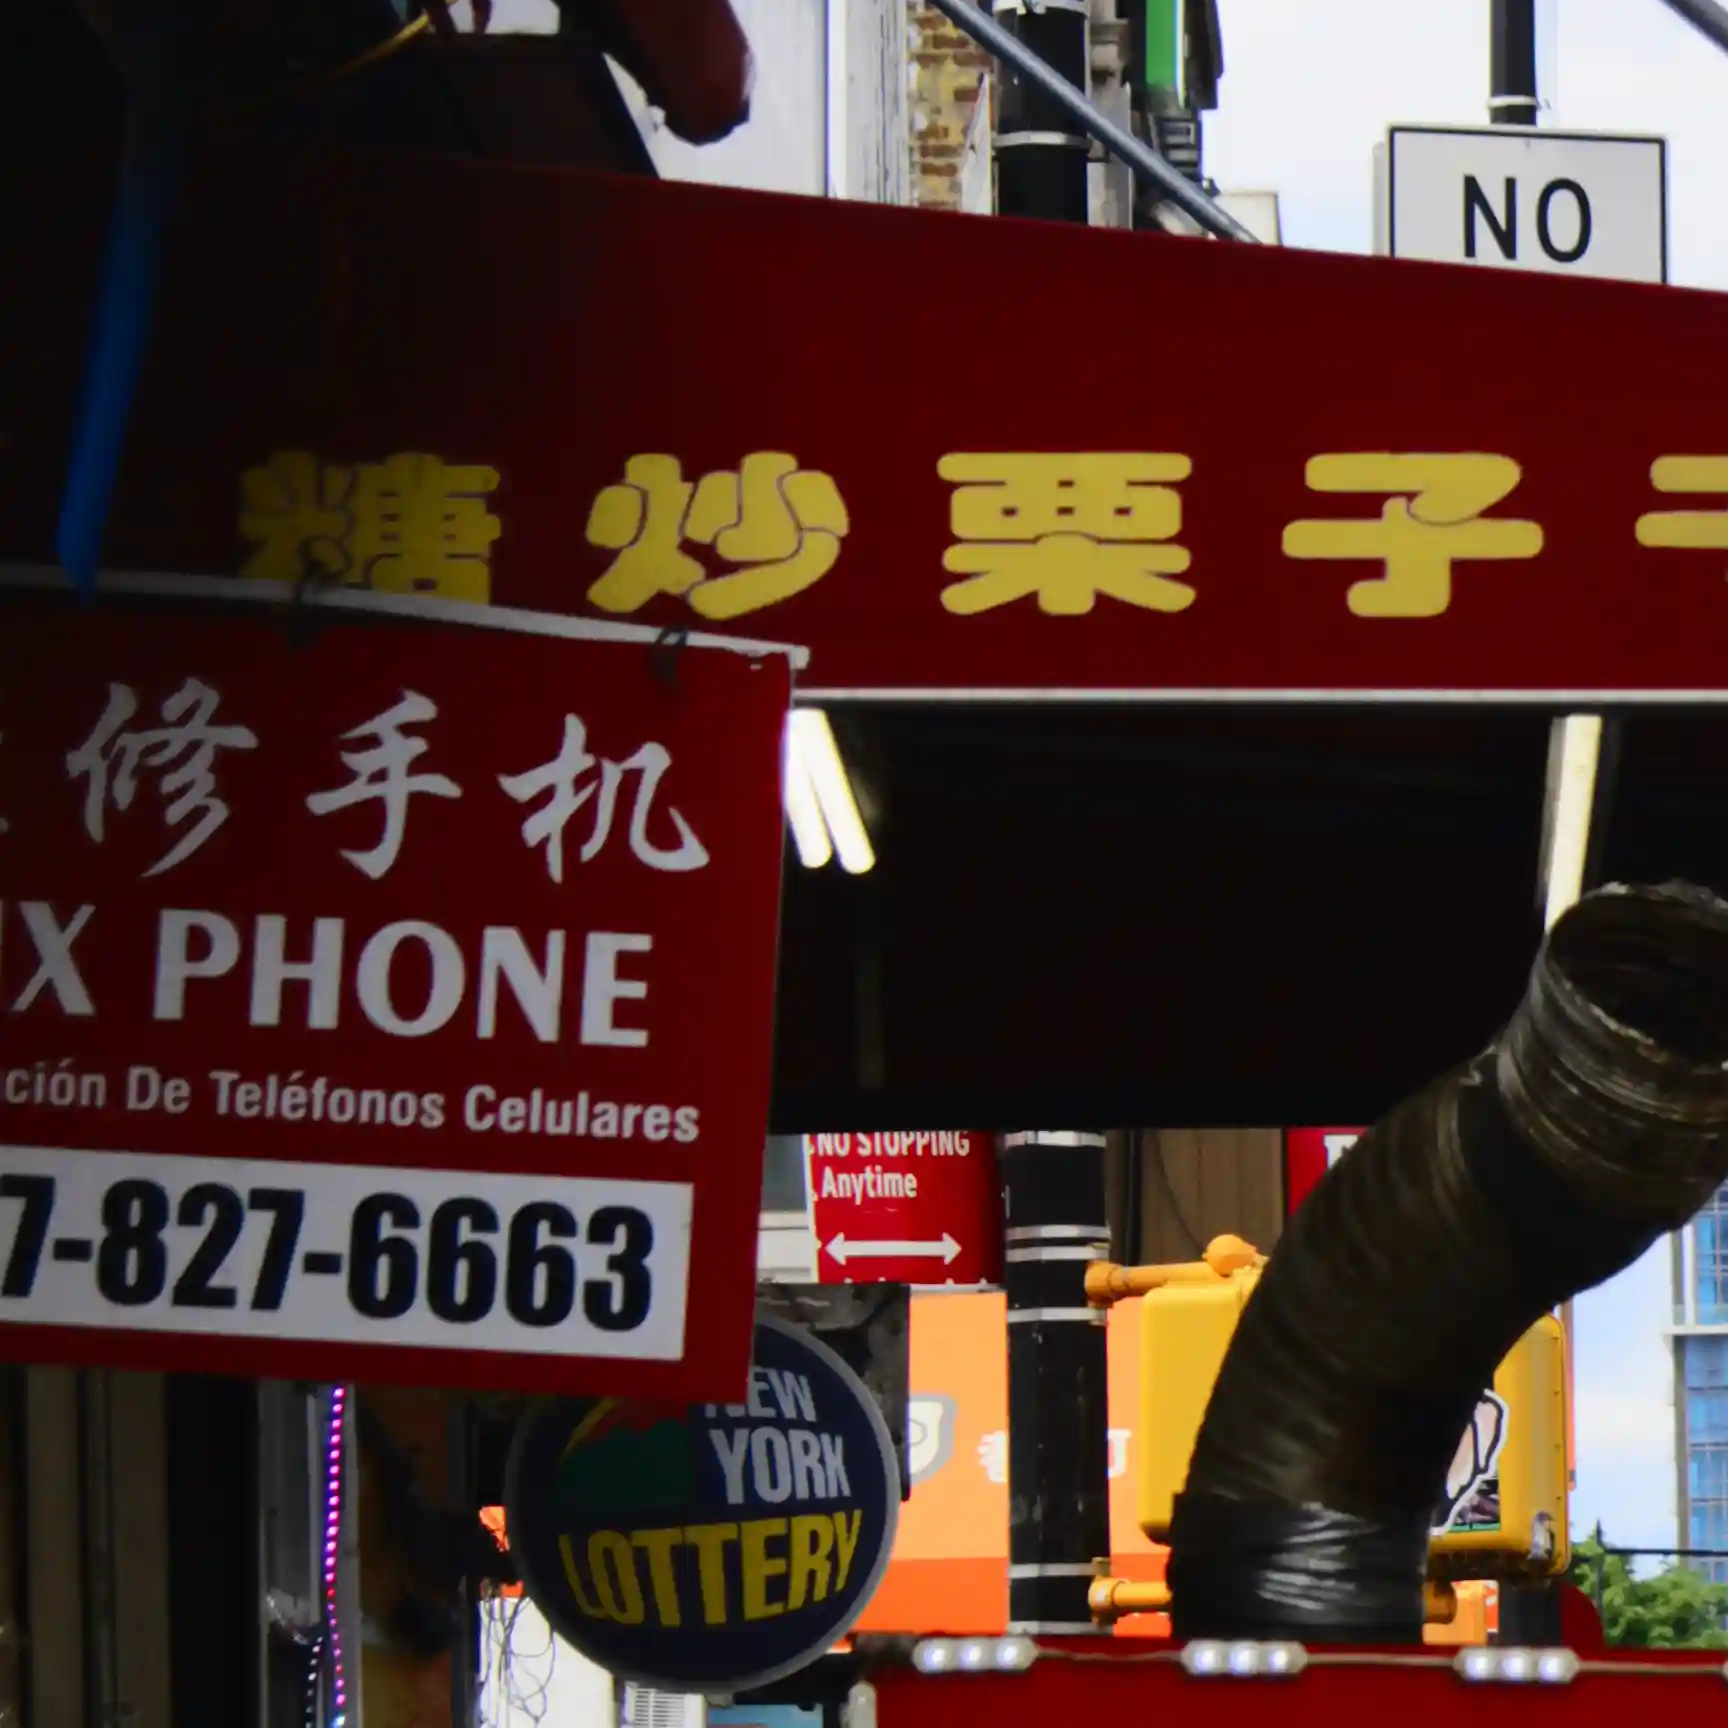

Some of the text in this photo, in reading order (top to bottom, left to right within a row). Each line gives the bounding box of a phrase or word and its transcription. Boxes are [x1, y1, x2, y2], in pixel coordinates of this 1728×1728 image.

[1461, 175, 1593, 264] NO
[0, 677, 710, 883] 修手机
[0, 899, 654, 1048] X PHONE
[127, 1067, 191, 1113] De
[210, 1070, 445, 1130] Teléfonos
[465, 1084, 700, 1142] Celulares
[817, 1130, 970, 1157] NO STOPPING
[821, 1165, 917, 1205] Anytime
[0, 1173, 654, 1333] 7-827-6663
[705, 1366, 817, 1423] EW
[709, 1426, 851, 1505] YORK
[558, 1509, 862, 1628] LOTTERY
